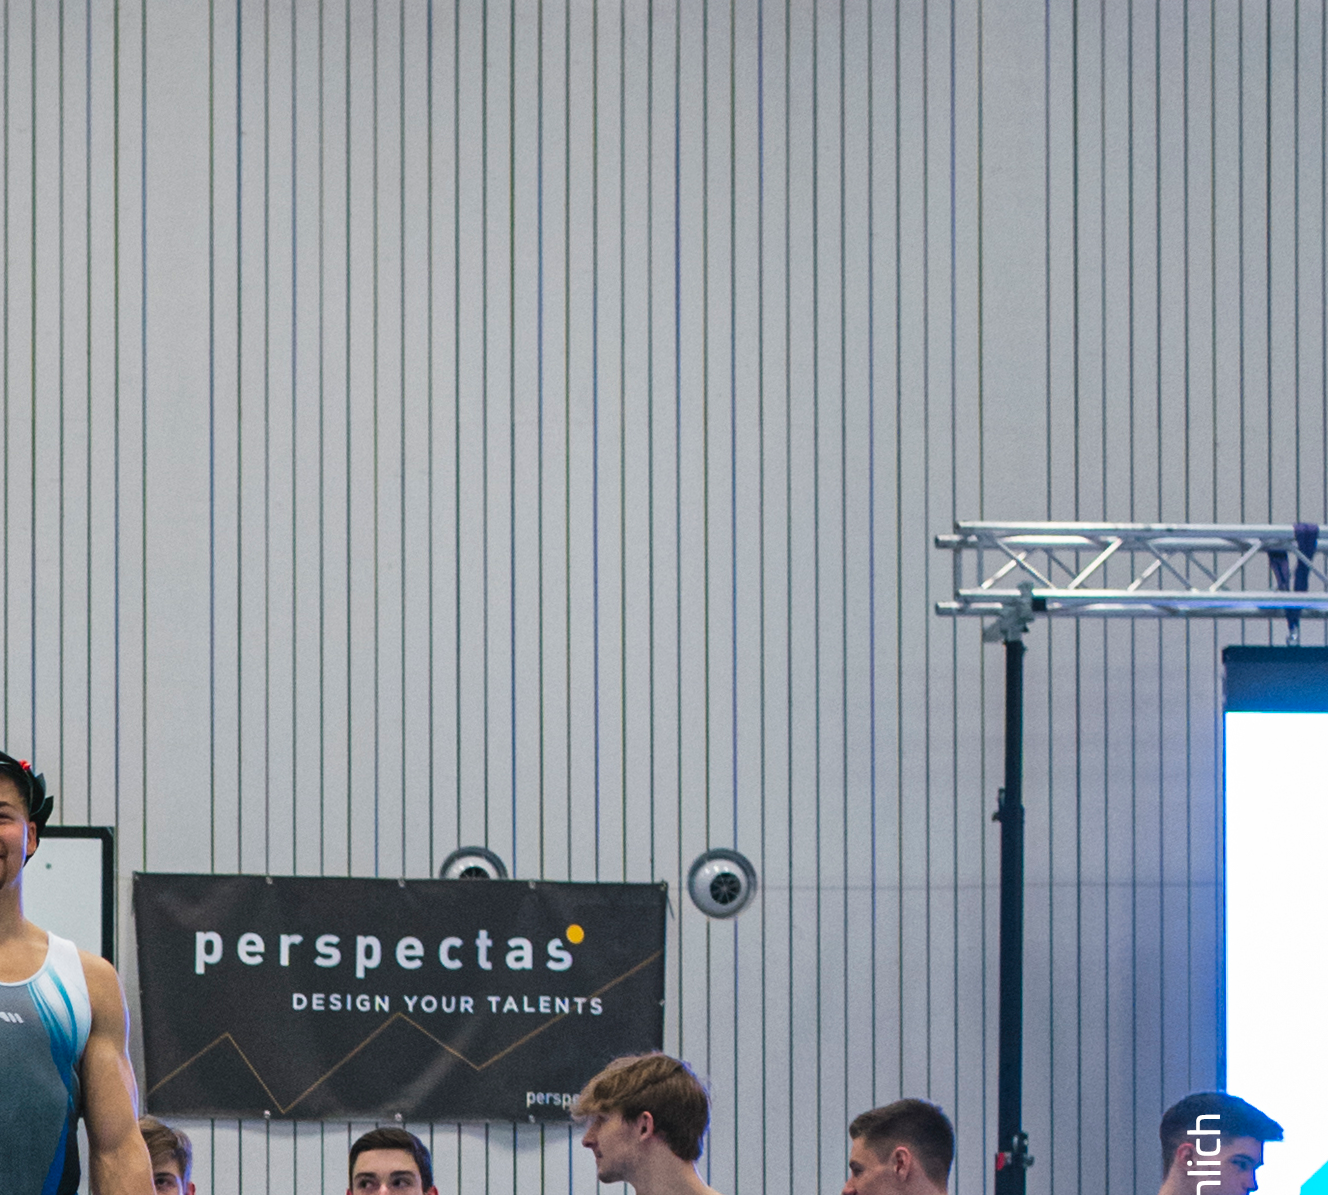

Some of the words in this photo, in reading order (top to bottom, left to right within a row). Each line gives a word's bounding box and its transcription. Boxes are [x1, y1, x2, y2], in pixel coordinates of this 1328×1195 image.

[195, 929, 573, 978] perspectas
[292, 993, 390, 1012] DESIGN
[404, 995, 474, 1013] YOUR
[487, 995, 603, 1015] TALENTS
